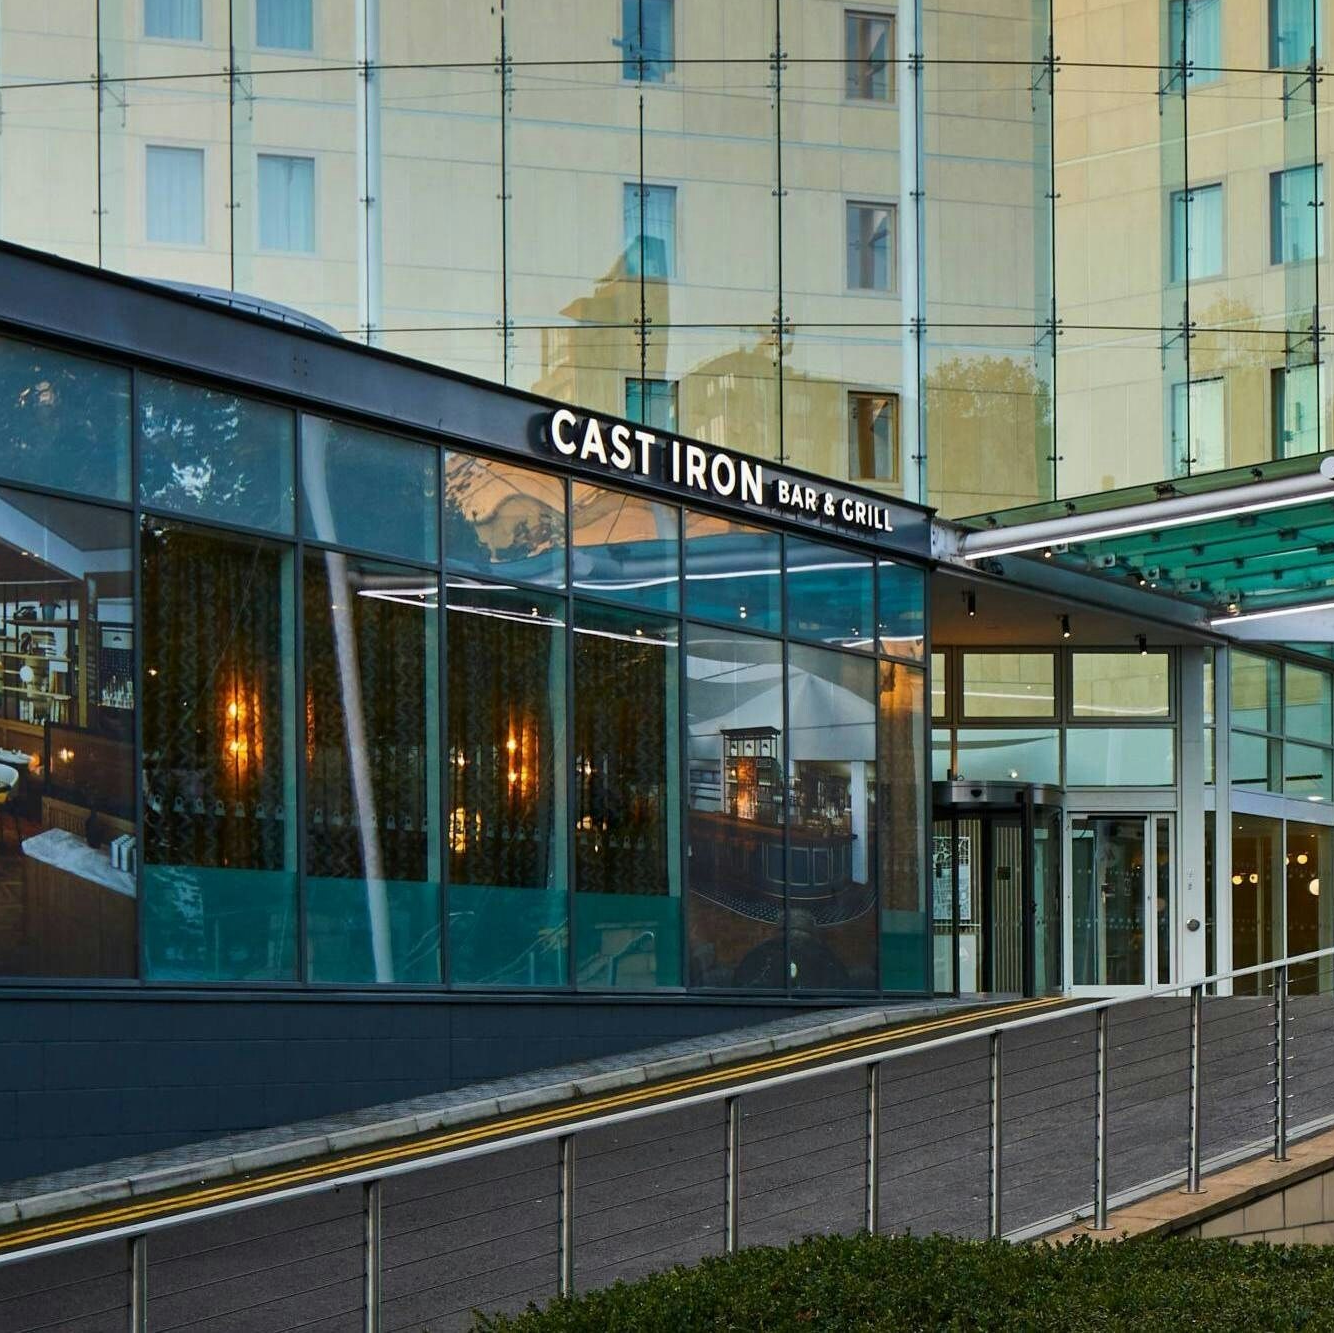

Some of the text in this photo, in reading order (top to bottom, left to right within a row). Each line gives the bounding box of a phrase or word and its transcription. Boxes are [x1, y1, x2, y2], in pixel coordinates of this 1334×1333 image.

[550, 408, 893, 532] CAST IRON BAR & GRILL
